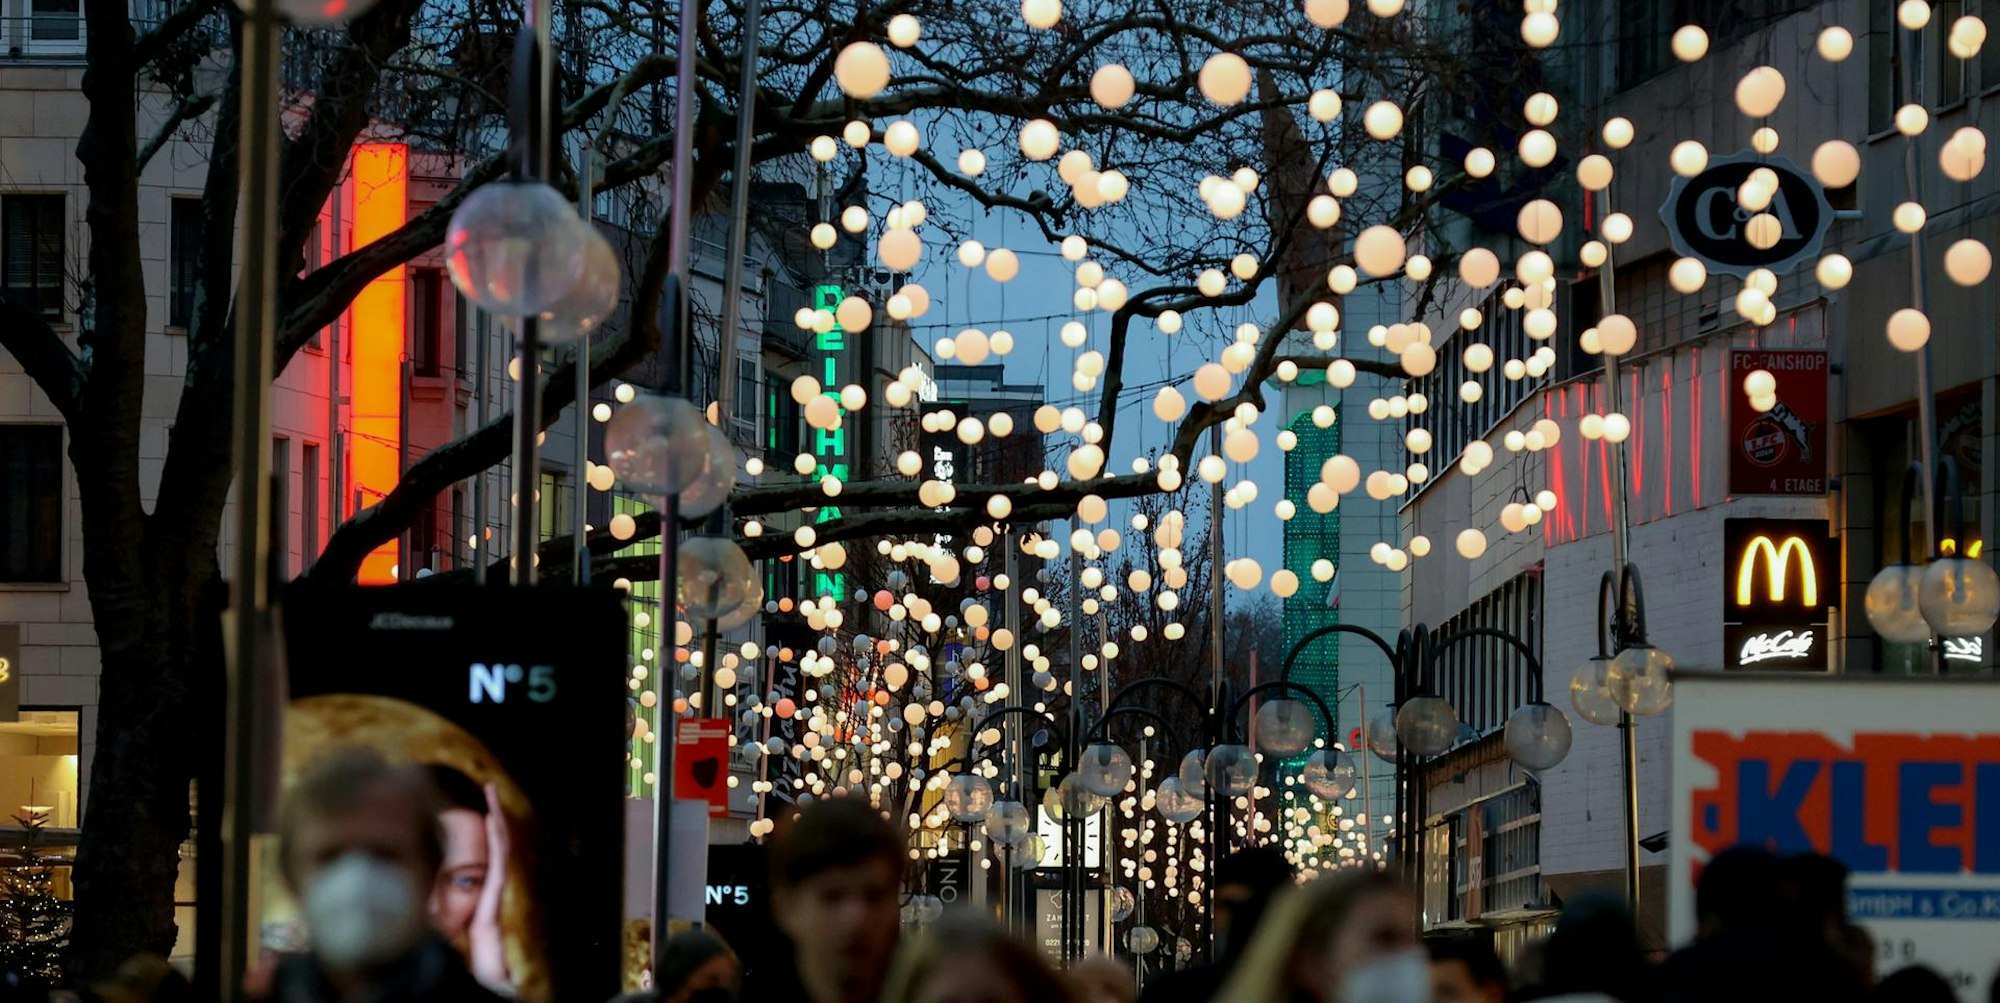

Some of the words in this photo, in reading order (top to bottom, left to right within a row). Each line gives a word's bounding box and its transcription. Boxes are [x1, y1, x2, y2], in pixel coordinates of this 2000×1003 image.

[1733, 354, 1825, 371] FC-FANSHOP
[811, 284, 848, 602] DEIHMAN
[1784, 478, 1822, 492] ETAGE
